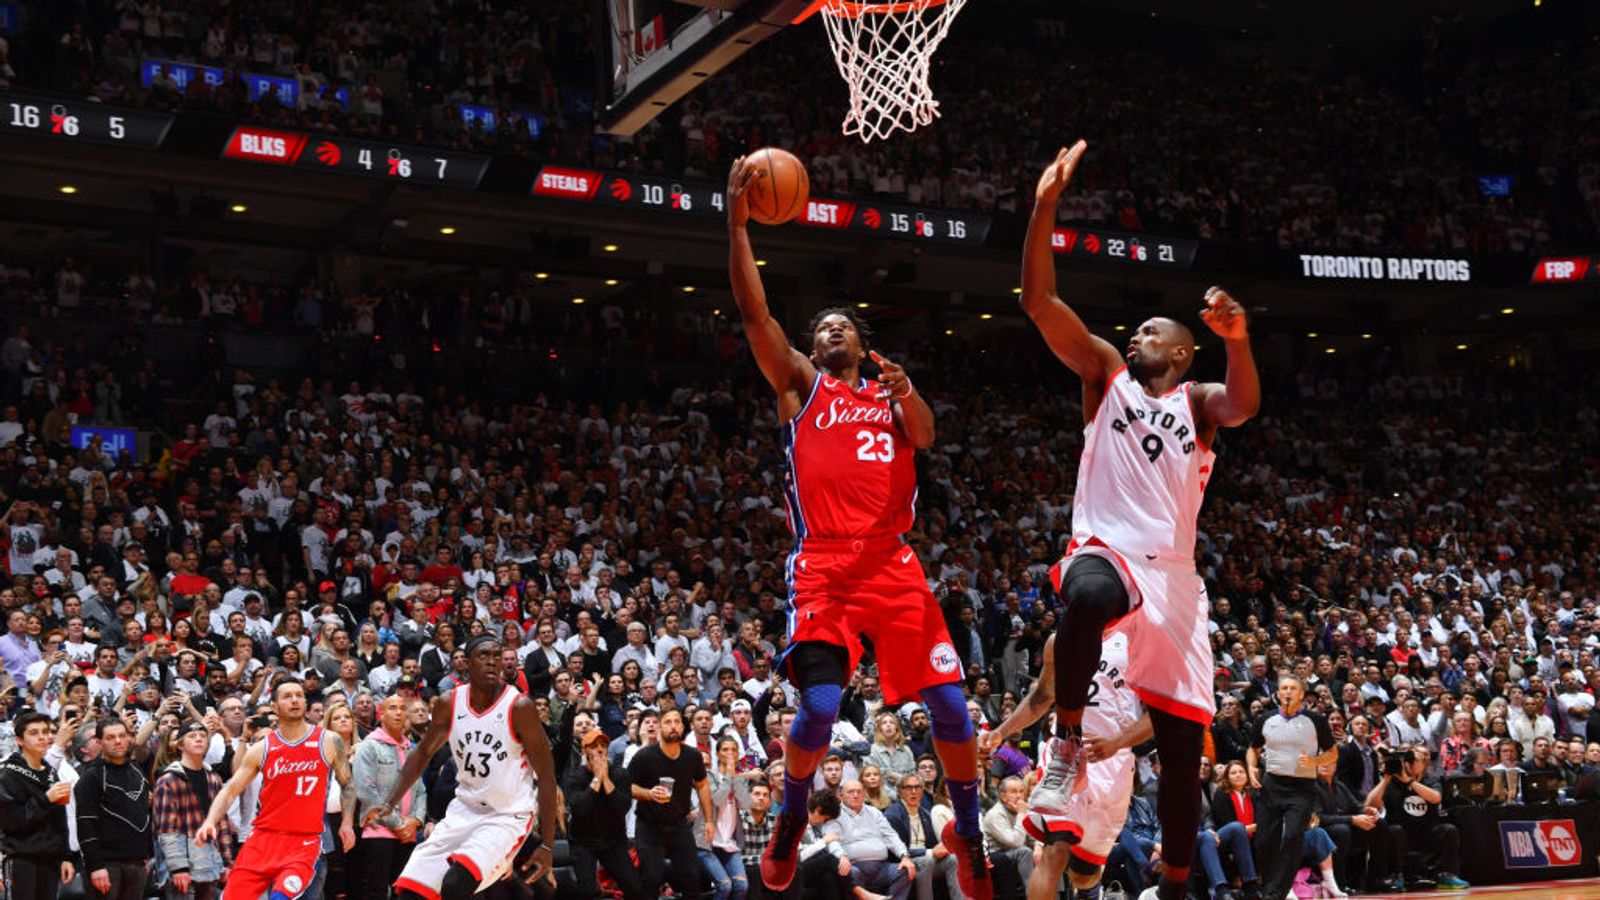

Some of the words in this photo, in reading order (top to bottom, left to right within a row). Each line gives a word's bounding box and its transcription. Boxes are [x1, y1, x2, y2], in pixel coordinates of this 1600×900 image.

[10, 103, 40, 128] 16
[50, 113, 80, 136] 76
[110, 116, 125, 139] 5
[240, 133, 286, 158] BLKS
[357, 149, 372, 170] 4
[387, 157, 412, 178] 76
[434, 158, 449, 179] 7
[542, 173, 588, 193] STEALS
[642, 184, 664, 205] 10
[711, 192, 724, 212] 4
[807, 201, 839, 224] AST
[890, 212, 910, 232] 15
[947, 219, 967, 239] 16
[1107, 238, 1126, 257] 22
[1158, 244, 1176, 263] 21
[1300, 254, 1384, 279] TORONTO
[1387, 257, 1471, 281] RAPTORS
[1545, 260, 1576, 280] FBP
[1112, 406, 1197, 455] RAPTORS
[856, 430, 895, 463] 23
[1141, 433, 1164, 463] 9
[455, 730, 508, 762] RAPTORS
[267, 756, 320, 780] Sixers
[463, 751, 492, 778] 43
[295, 776, 319, 796] 17
[1403, 801, 1428, 812] TNT
[1507, 831, 1536, 858] NBA
[1550, 837, 1576, 852] TNT
